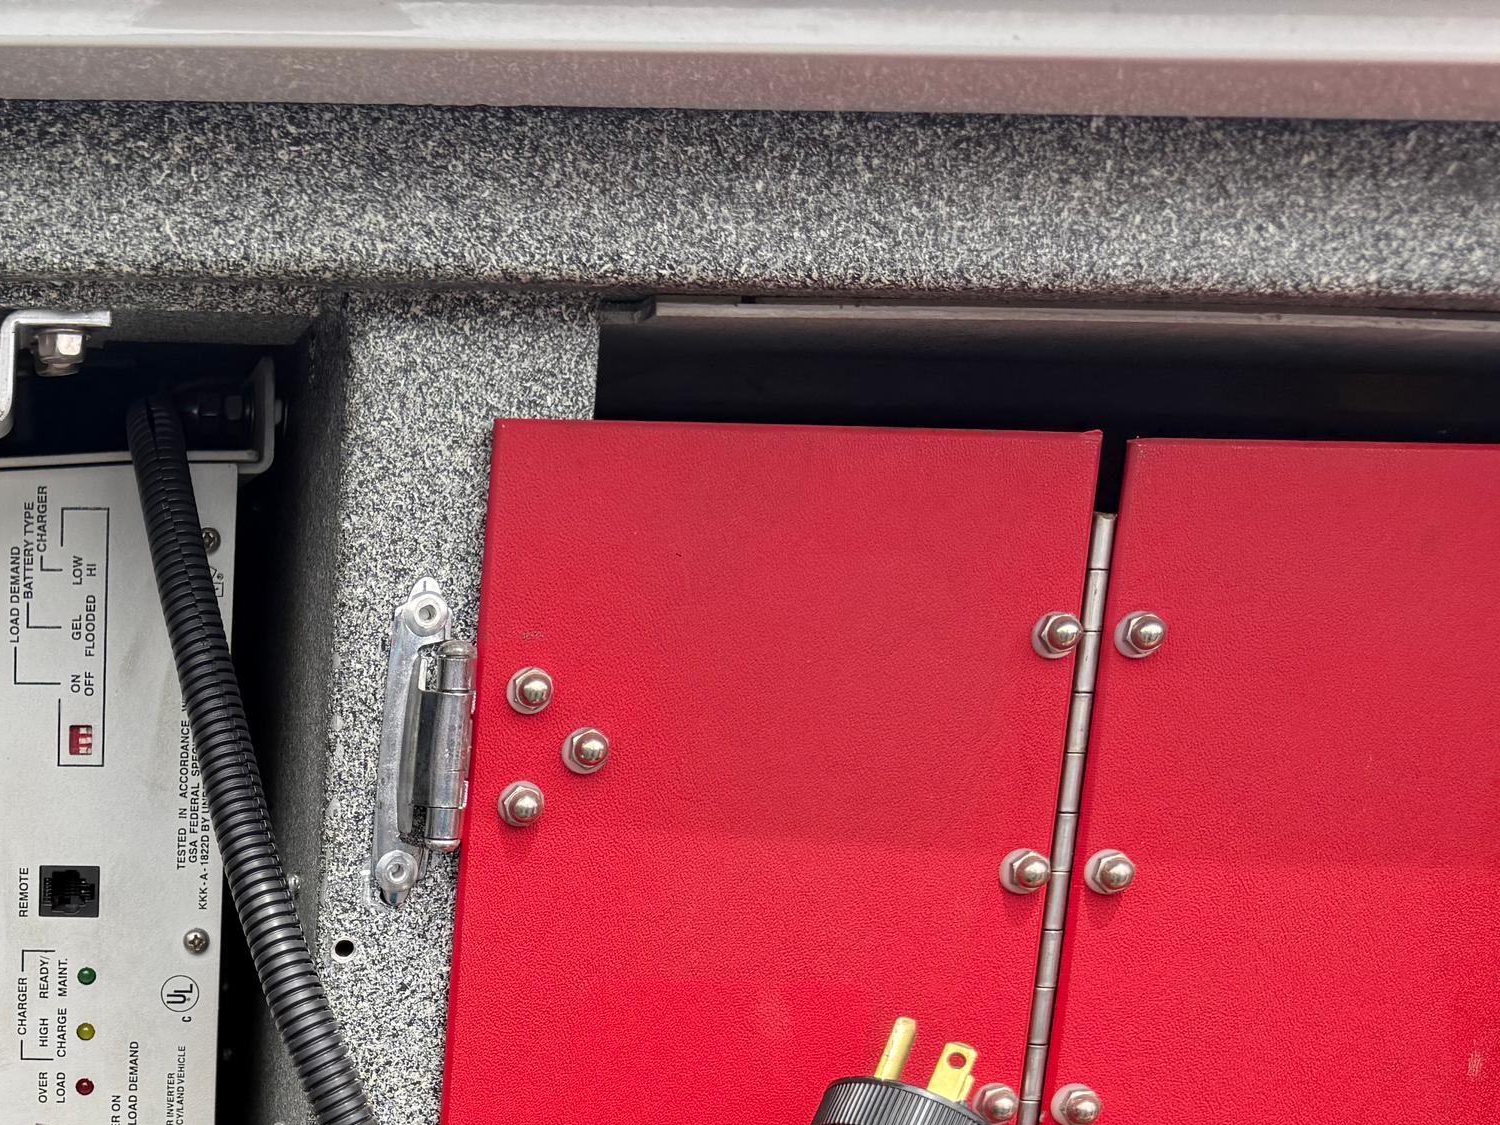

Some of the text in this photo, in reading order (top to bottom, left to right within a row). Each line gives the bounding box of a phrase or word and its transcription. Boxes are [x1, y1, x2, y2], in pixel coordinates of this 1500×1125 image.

[38, 486, 47, 552] CHARGER
[24, 502, 34, 599] BATTERY TYPE
[87, 563, 96, 577] HI
[73, 556, 82, 585] LOW
[10, 547, 20, 643] LOAD DEMAND
[72, 615, 81, 640] GEL
[85, 595, 95, 656] FLOODED
[71, 674, 80, 693] ON
[85, 672, 94, 697] OFF
[179, 720, 189, 798] ACCORDANCE
[178, 808, 186, 819] IN
[190, 783, 199, 833] FEDERAL
[201, 817, 209, 832] BY
[177, 828, 186, 870] TESTED
[189, 840, 198, 863] GSA
[19, 868, 29, 917] REMOTE
[39, 956, 49, 999] READY/
[58, 958, 68, 997] MAINT.
[18, 977, 27, 1035] CHARGER
[39, 1018, 49, 1047] HIGH
[57, 1008, 67, 1057] CHARGE
[129, 1041, 139, 1090] DEMAND
[177, 1046, 185, 1085] VEHICLE
[38, 1072, 48, 1103] OVER
[56, 1072, 65, 1104] LOAD
[112, 1095, 120, 1111] ON
[166, 1073, 174, 1118] INVERTER
